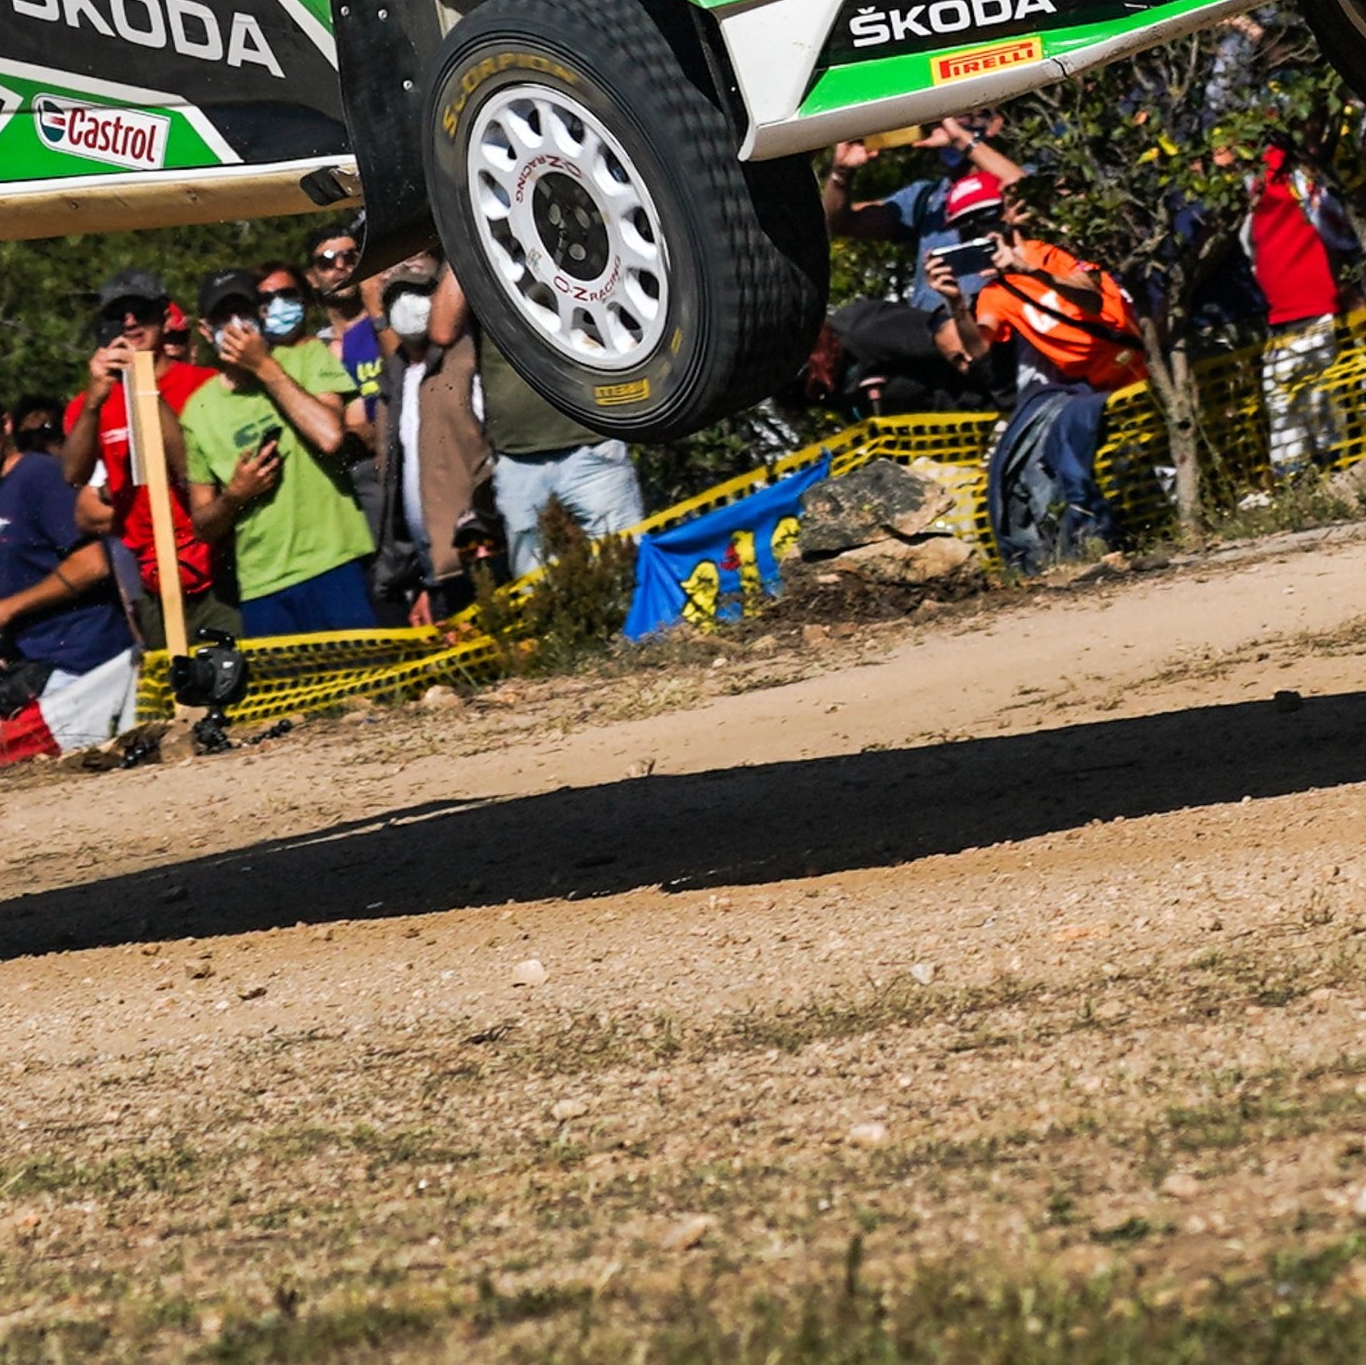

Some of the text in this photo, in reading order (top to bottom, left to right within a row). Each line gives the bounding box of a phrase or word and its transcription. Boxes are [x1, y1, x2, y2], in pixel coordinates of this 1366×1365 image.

[939, 42, 1034, 79] PIRELLI
[68, 107, 157, 163] Castrol
[515, 155, 547, 203] RACING
[590, 255, 622, 301] RACING
